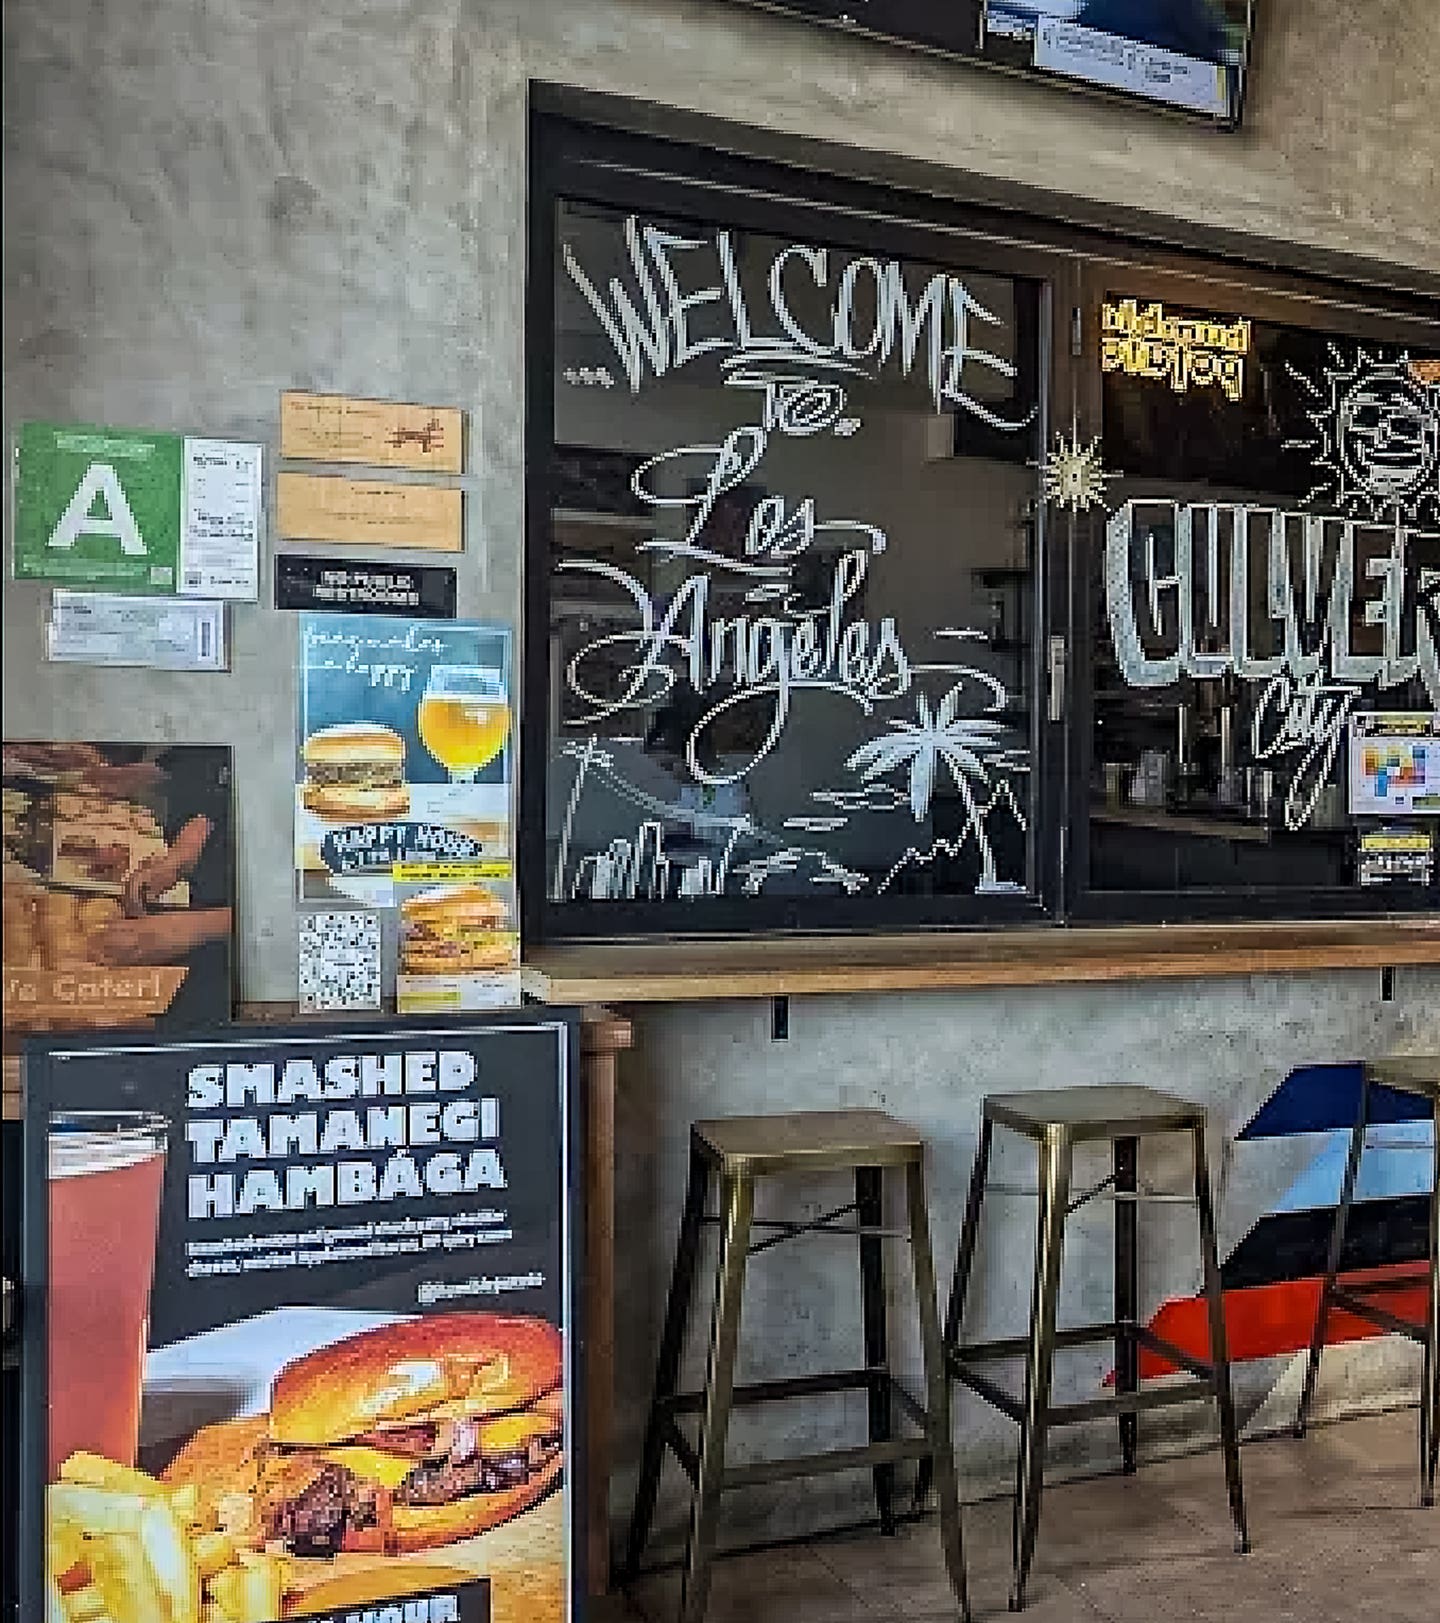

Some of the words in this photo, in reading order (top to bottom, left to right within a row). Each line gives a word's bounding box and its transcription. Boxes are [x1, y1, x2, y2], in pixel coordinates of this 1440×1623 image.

[563, 214, 1039, 432] WELCOME
[46, 461, 149, 555] A
[630, 427, 888, 576] Los
[557, 550, 1009, 786] Angeles
[1251, 674, 1362, 831] City
[186, 1098, 500, 1163] TAMANEGI
[187, 1051, 478, 1108] SMASHED
